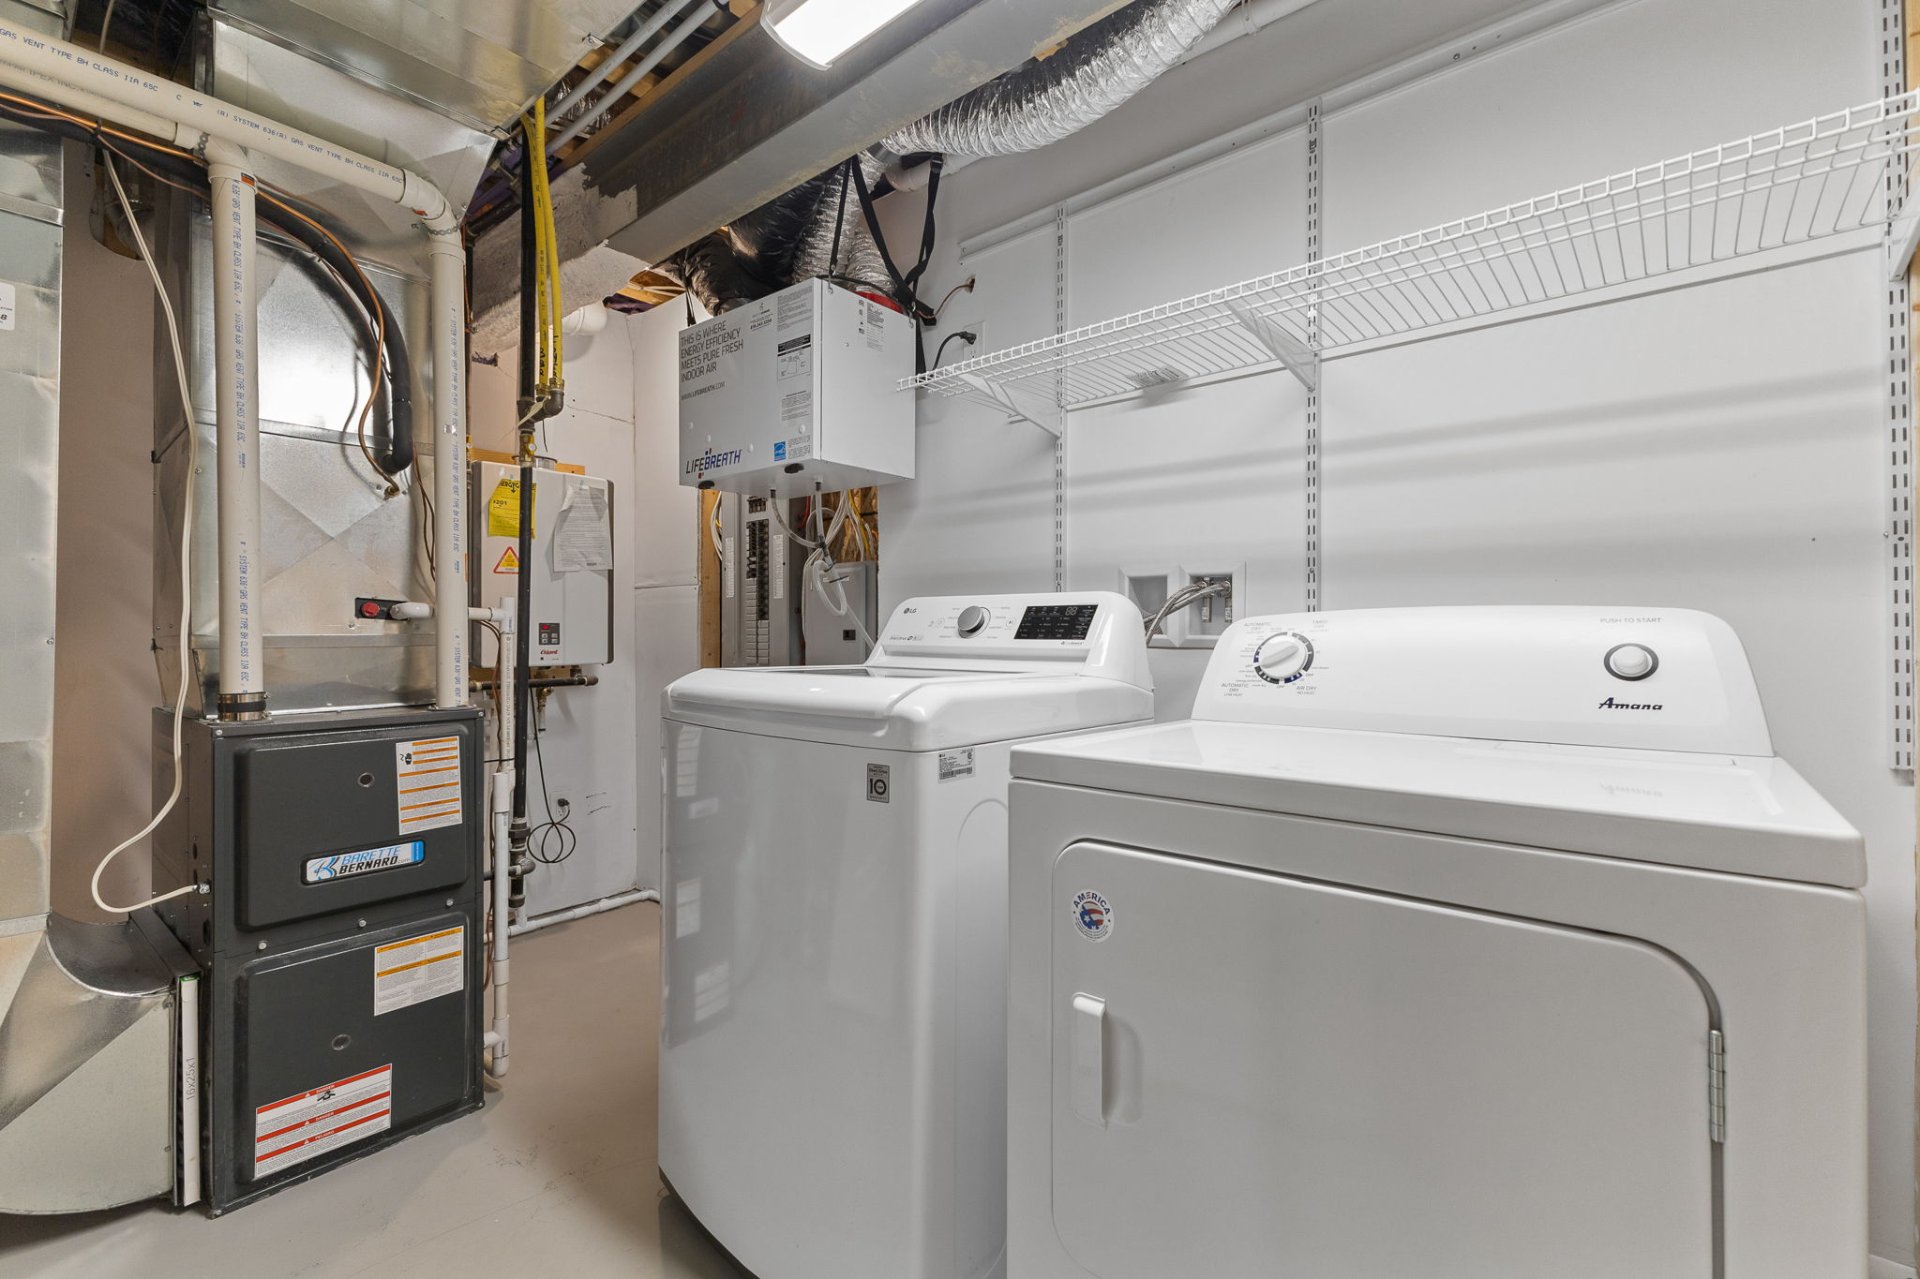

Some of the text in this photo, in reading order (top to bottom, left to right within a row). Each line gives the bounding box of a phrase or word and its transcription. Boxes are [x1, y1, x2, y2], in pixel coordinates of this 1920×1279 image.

[0, 27, 17, 41] GAS
[23, 38, 46, 50] VENT
[51, 47, 73, 61] TYPE
[77, 56, 89, 67] BH
[93, 62, 119, 78] CLASS
[143, 80, 159, 92] 65C
[233, 115, 260, 131] SYSTEM
[290, 136, 305, 148] GAS
[307, 143, 324, 155] VENT
[326, 149, 342, 162] TYPE
[344, 156, 354, 166] BH
[356, 161, 375, 174] CLASS
[681, 320, 727, 348] THIS IS WHERE
[681, 328, 741, 359] ENERGY EFFICIENCY
[681, 339, 744, 370] MEETS PURE FRESH
[681, 361, 717, 383] INDOOR AIR
[686, 449, 743, 474] LIFEBREATH
[239, 555, 248, 574] SYSTEM
[240, 601, 249, 615] VENT
[240, 617, 249, 630] TYPE
[240, 640, 249, 658] CLASS
[1598, 696, 1663, 711] Amana
[870, 778, 887, 796] 10
[341, 846, 401, 866] BARETTE
[1073, 891, 1111, 915] AMERICA
[185, 1057, 195, 1100] 16x25x1
